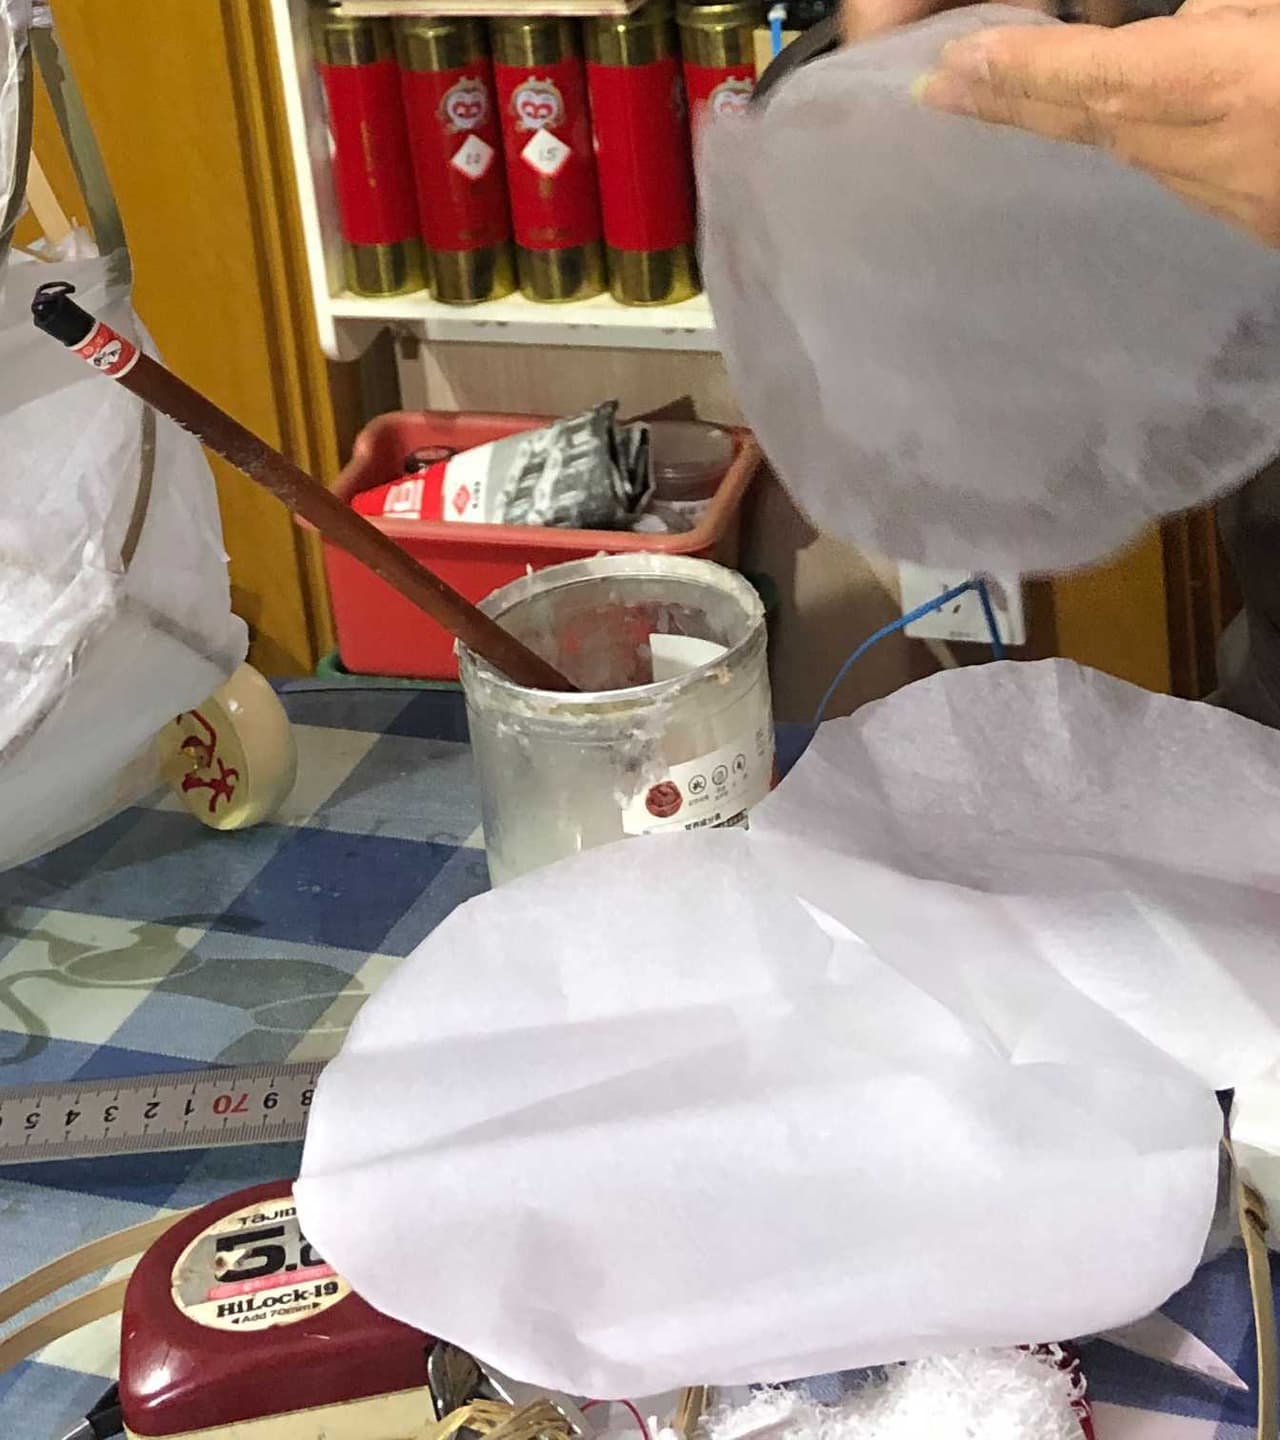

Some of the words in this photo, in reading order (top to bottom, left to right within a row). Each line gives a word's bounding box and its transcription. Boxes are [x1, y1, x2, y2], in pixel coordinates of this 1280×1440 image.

[212, 1092, 249, 1116] 70
[263, 1090, 279, 1109] 9
[300, 1088, 314, 1107] 8
[103, 1104, 119, 1122] 3
[143, 1101, 160, 1119] 2
[183, 1098, 193, 1116] 1
[24, 1112, 40, 1130] 5
[64, 1108, 81, 1125] 4
[241, 1312, 267, 1324] Add
